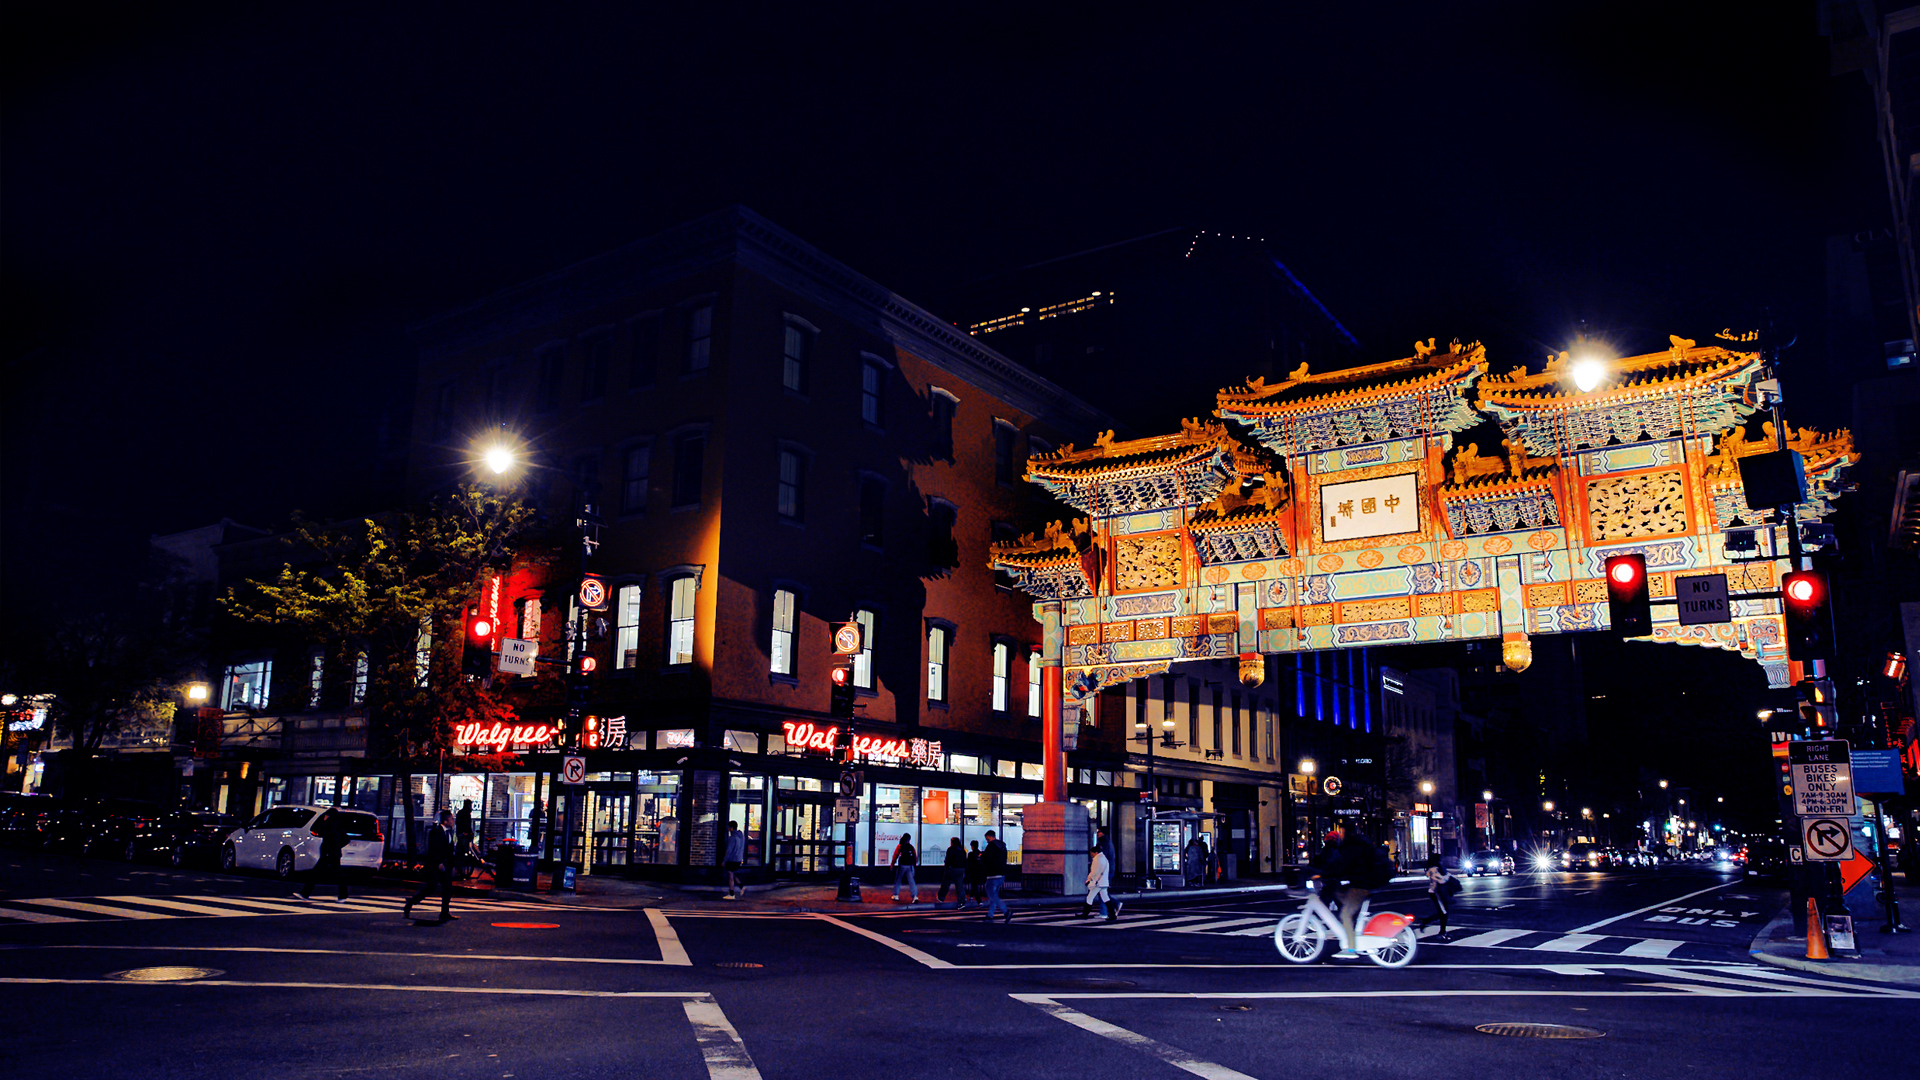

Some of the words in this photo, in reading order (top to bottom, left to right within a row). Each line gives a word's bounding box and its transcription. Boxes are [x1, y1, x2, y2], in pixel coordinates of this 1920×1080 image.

[1692, 580, 1710, 593] NO
[1683, 598, 1724, 613] TURNS
[513, 643, 525, 652] NO
[504, 654, 530, 666] TURNS
[1803, 764, 1838, 774] BUSES
[1806, 773, 1837, 783] BIKES
[1808, 782, 1837, 792] ONLY
[1806, 805, 1845, 813] MON-FRI
[1658, 906, 1760, 918] ONLY
[1643, 915, 1740, 928] BUS
